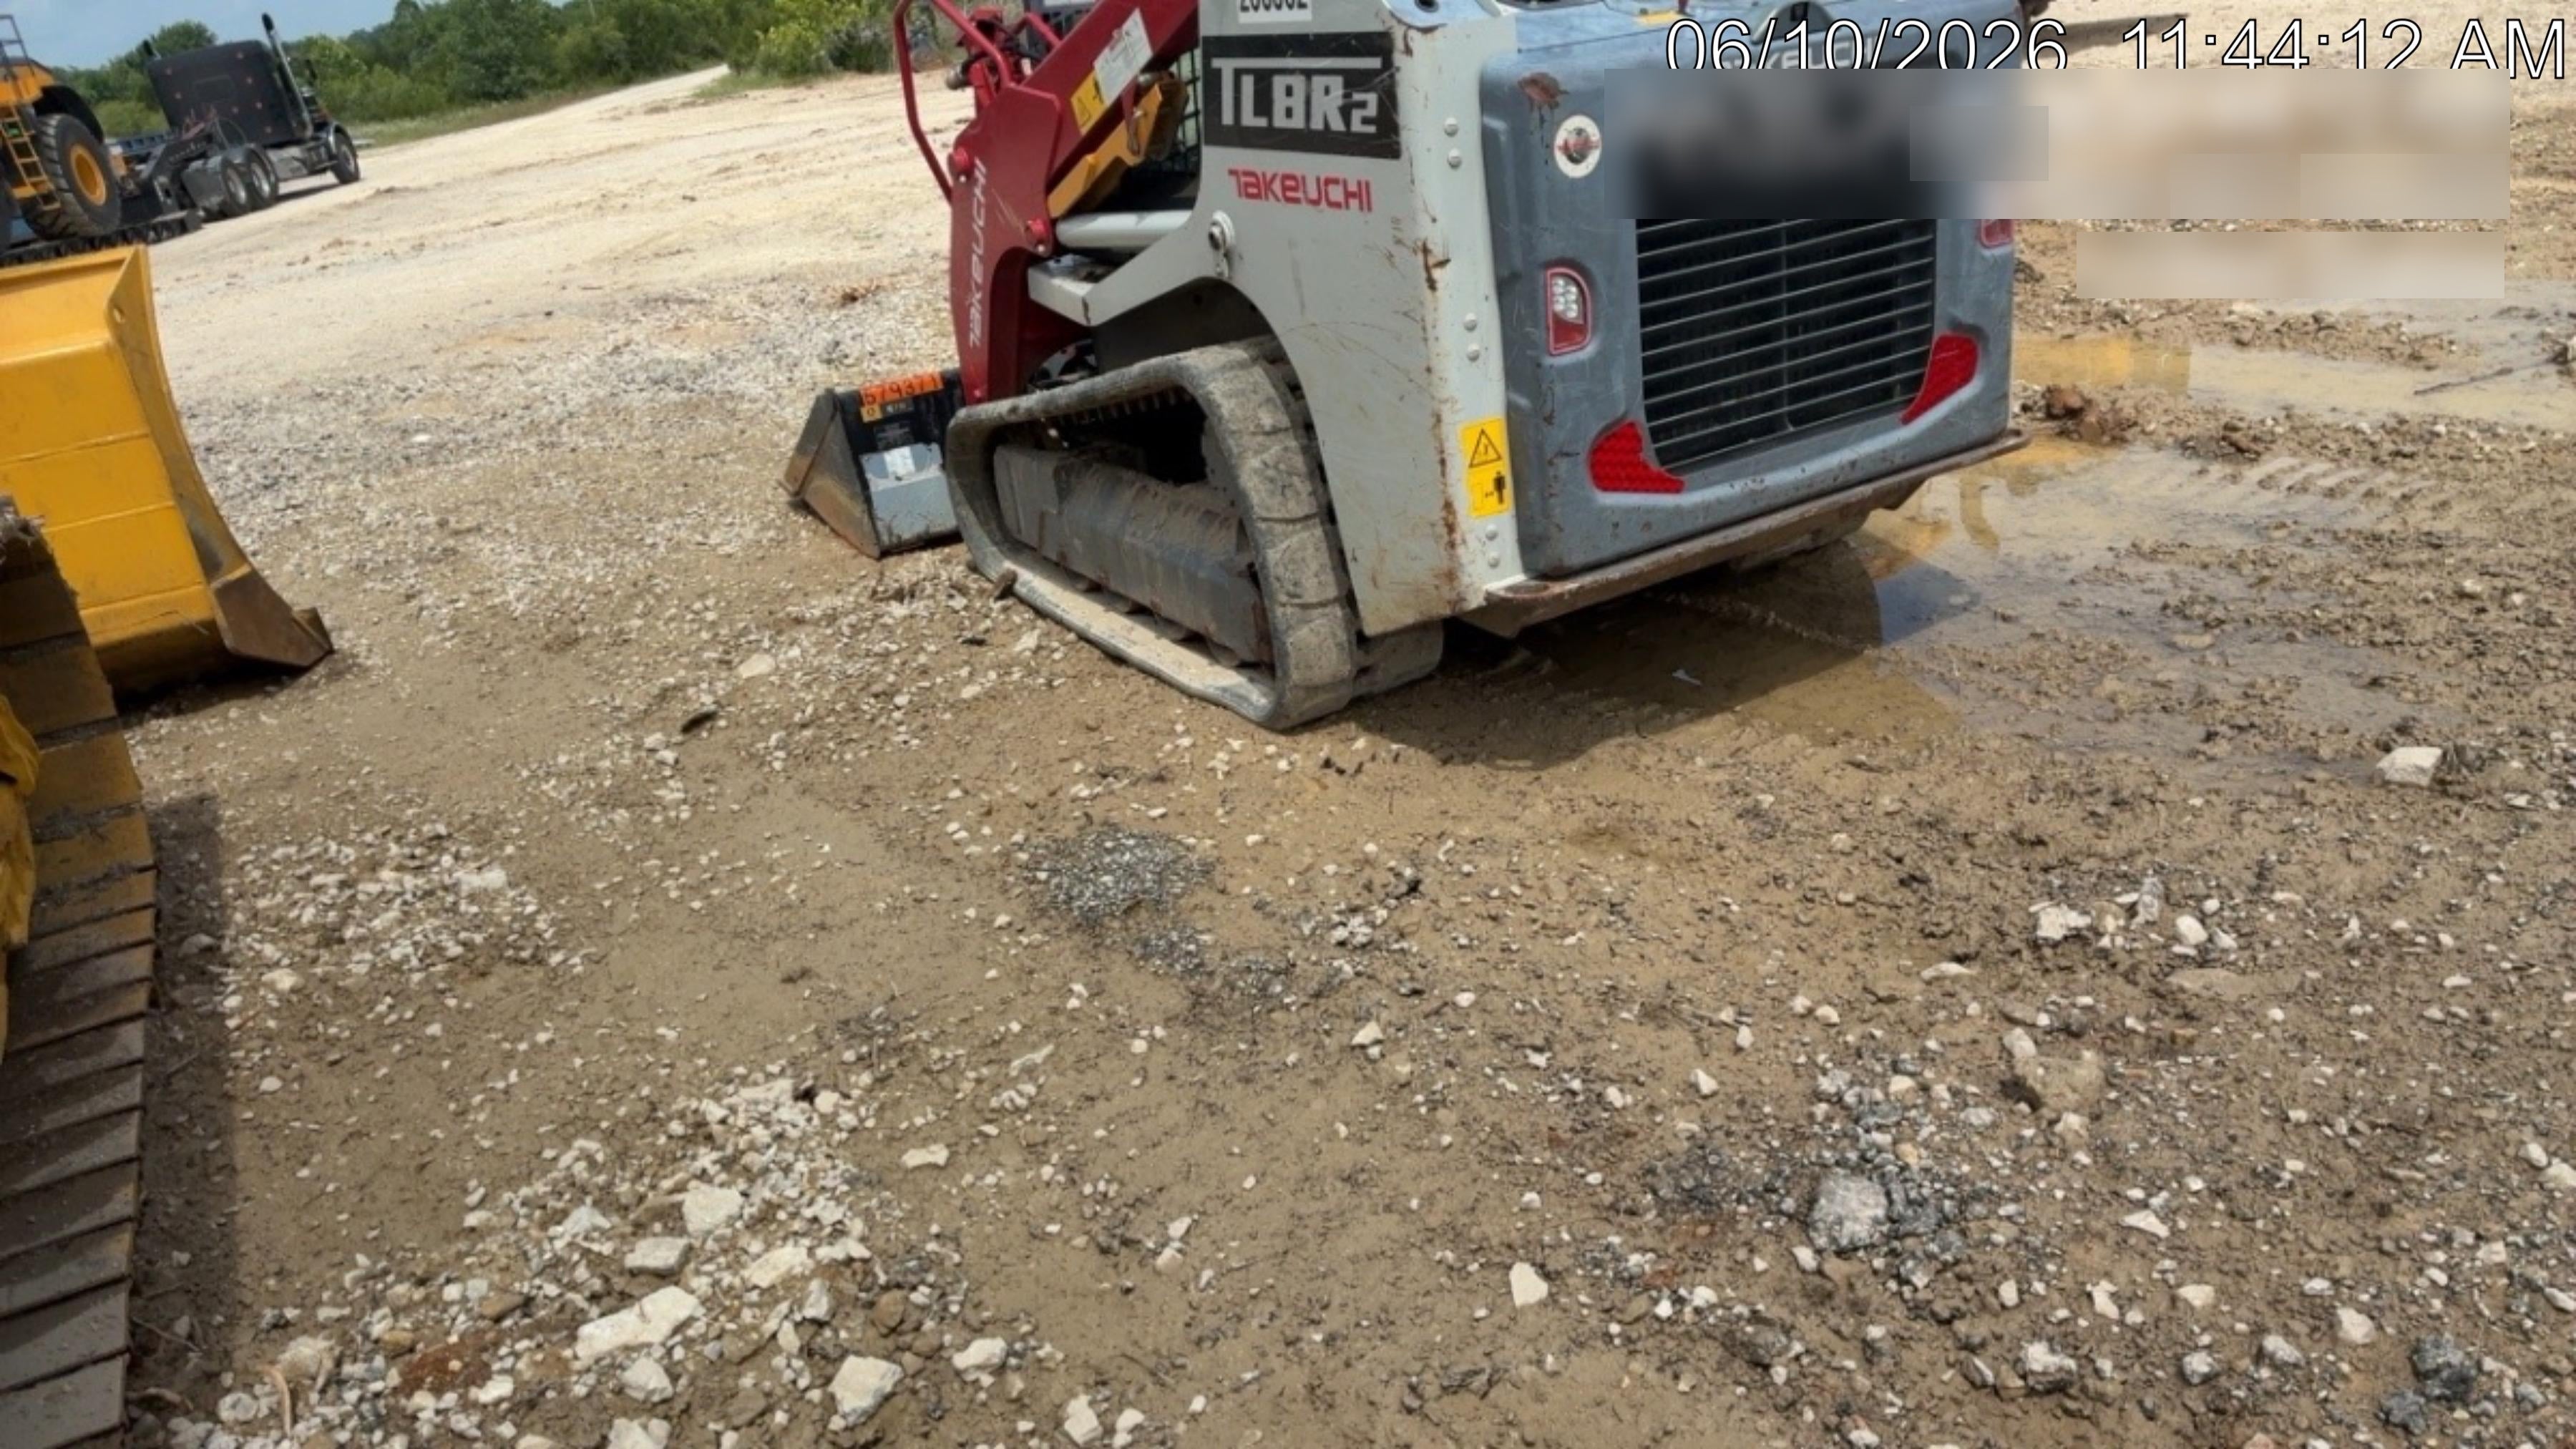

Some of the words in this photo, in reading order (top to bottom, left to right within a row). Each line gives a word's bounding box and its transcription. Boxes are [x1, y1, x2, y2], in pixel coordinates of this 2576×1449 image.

[1211, 57, 1382, 134] TL8R2
[1227, 168, 1372, 213] TAKEUCHI
[970, 155, 987, 348] TAKEUCHI
